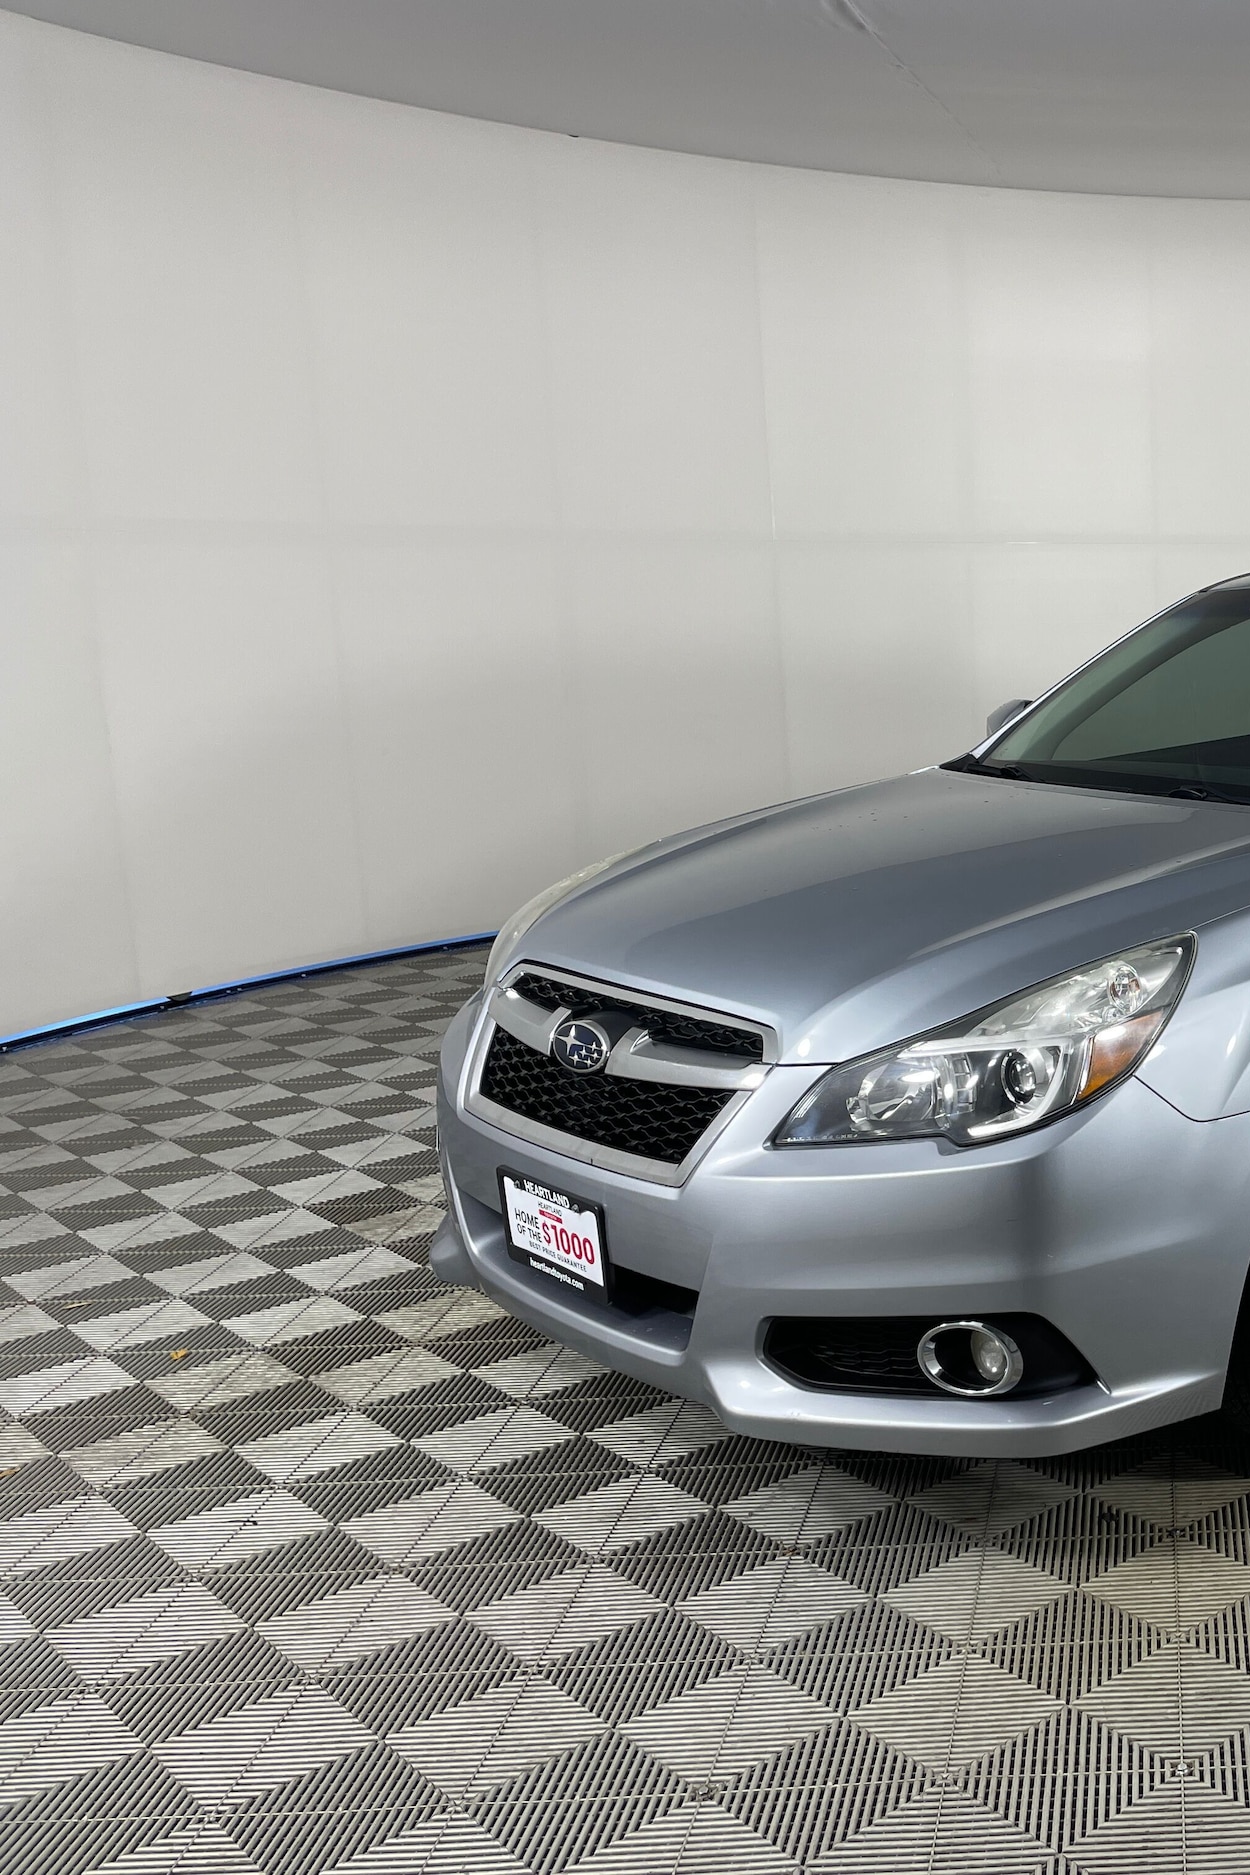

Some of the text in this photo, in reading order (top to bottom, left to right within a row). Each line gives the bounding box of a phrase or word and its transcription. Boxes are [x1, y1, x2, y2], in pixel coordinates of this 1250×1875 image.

[523, 1179, 570, 1209] HEARTLAND
[514, 1207, 595, 1265] HOME $1000
[516, 1223, 542, 1243] OF THE
[529, 1257, 585, 1291] heartlandtoyota.com
[556, 1253, 587, 1273] GUARANTEE
